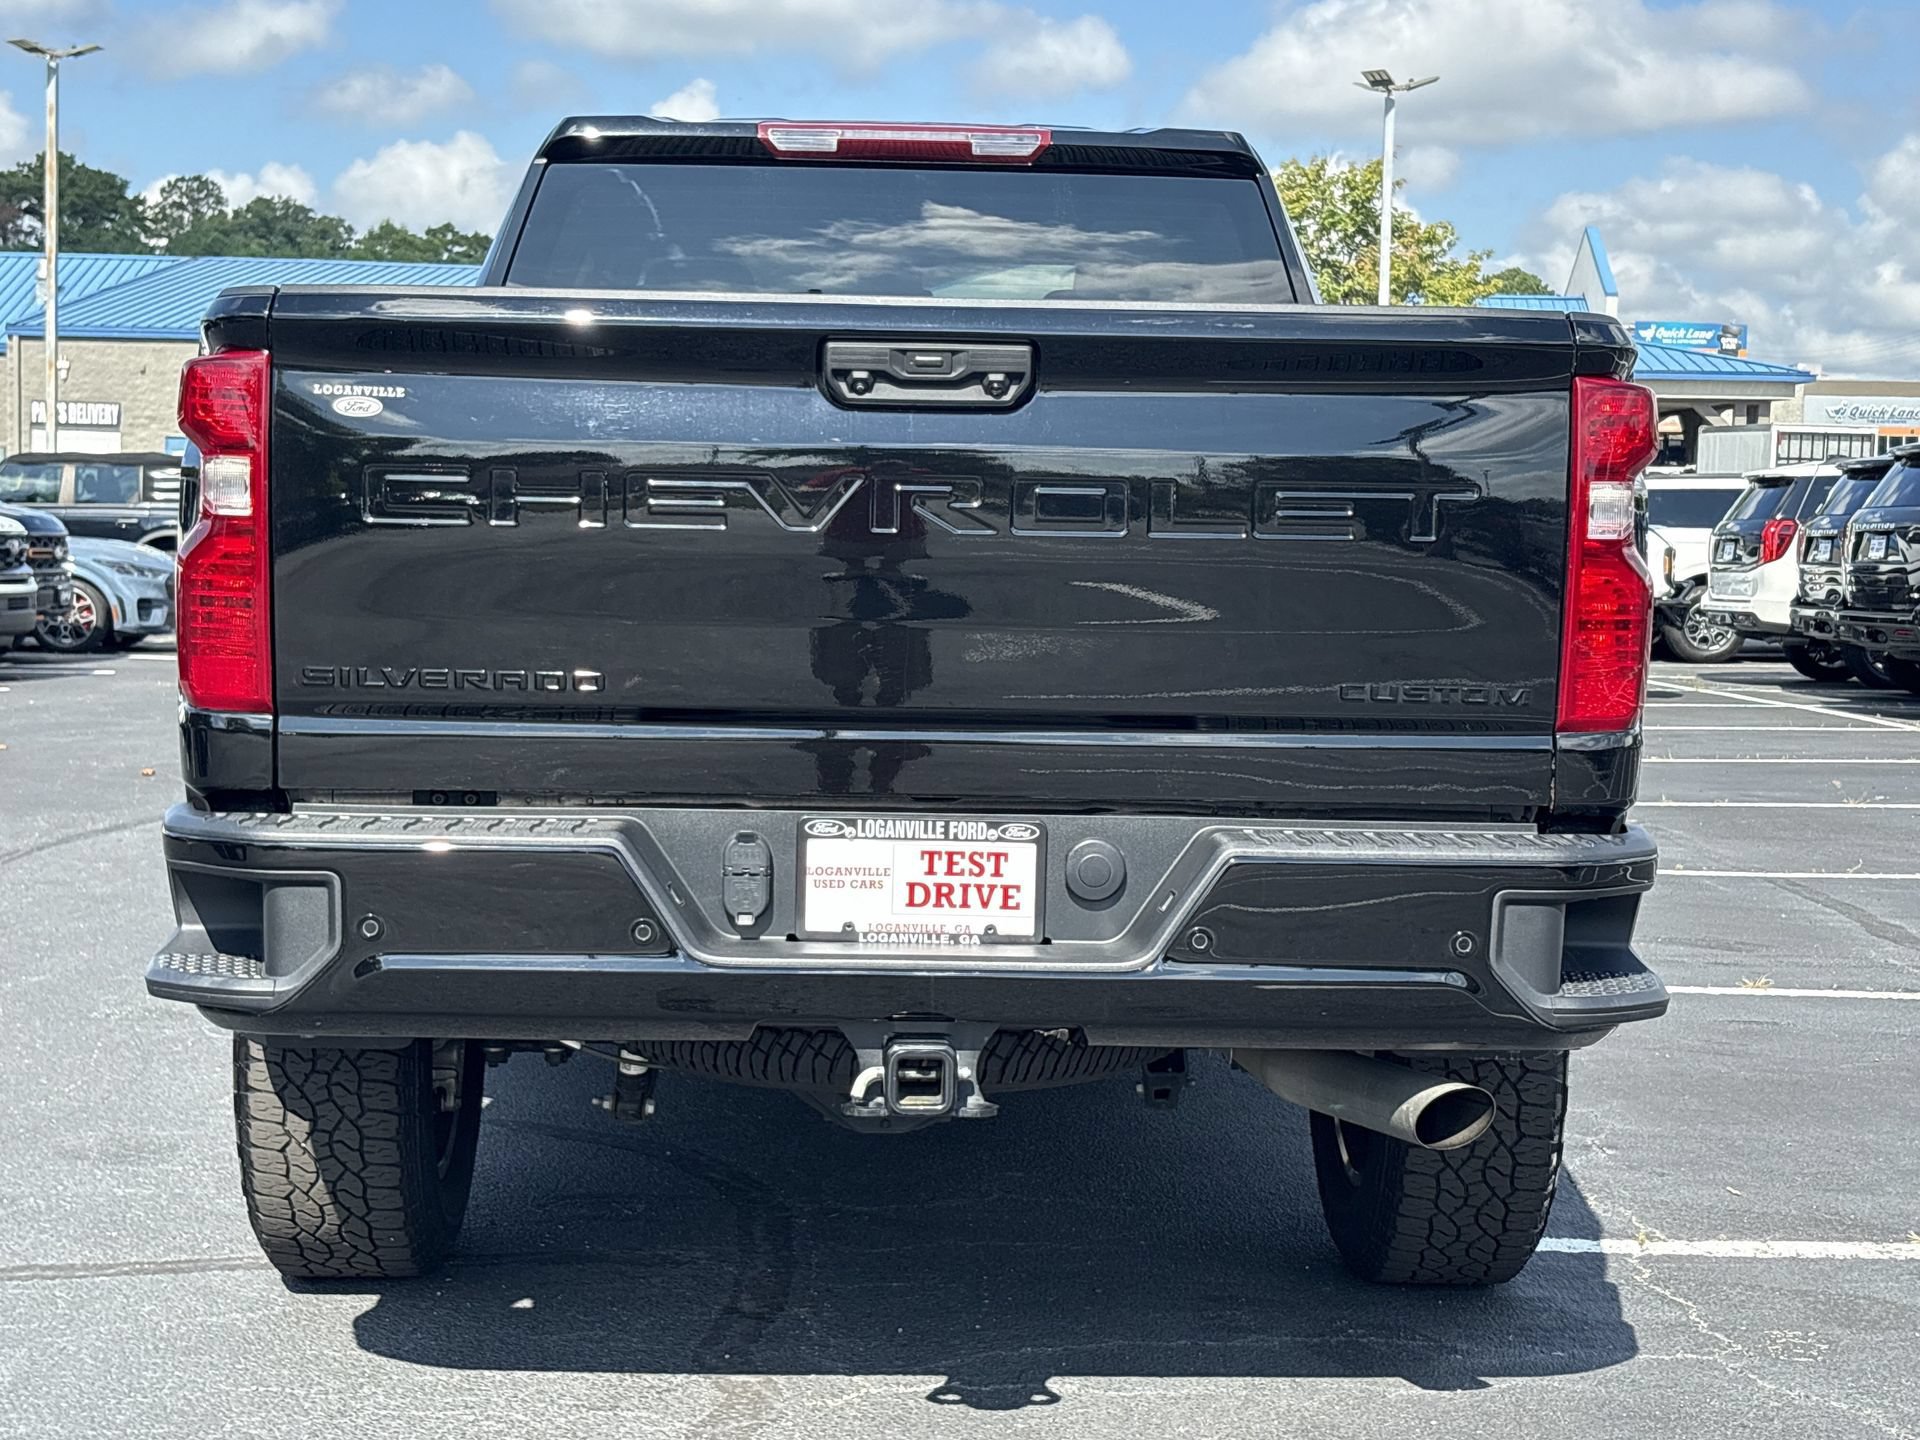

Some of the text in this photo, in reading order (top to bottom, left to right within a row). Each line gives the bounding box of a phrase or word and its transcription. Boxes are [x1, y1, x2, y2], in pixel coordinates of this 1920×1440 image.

[1655, 326, 1687, 340] Quick
[313, 383, 406, 398] LOGANVILLE
[31, 400, 119, 425] PAS DELIVERY
[343, 400, 372, 413] Ford
[1848, 405, 1889, 420] Quick
[361, 463, 1483, 544] CHEVROLET
[302, 666, 606, 692] SILVERADO
[1337, 683, 1533, 707] CUSTOM
[812, 822, 839, 834] Ford
[857, 819, 988, 840] LOGANVILLE FORD
[1005, 826, 1032, 838] Ford
[920, 849, 1009, 878] TEST
[805, 866, 892, 877] LOGANVILLE
[813, 879, 885, 890] USED CARS
[905, 881, 1022, 911] DRIVE
[954, 924, 972, 935] GA
[958, 934, 981, 945] GA
